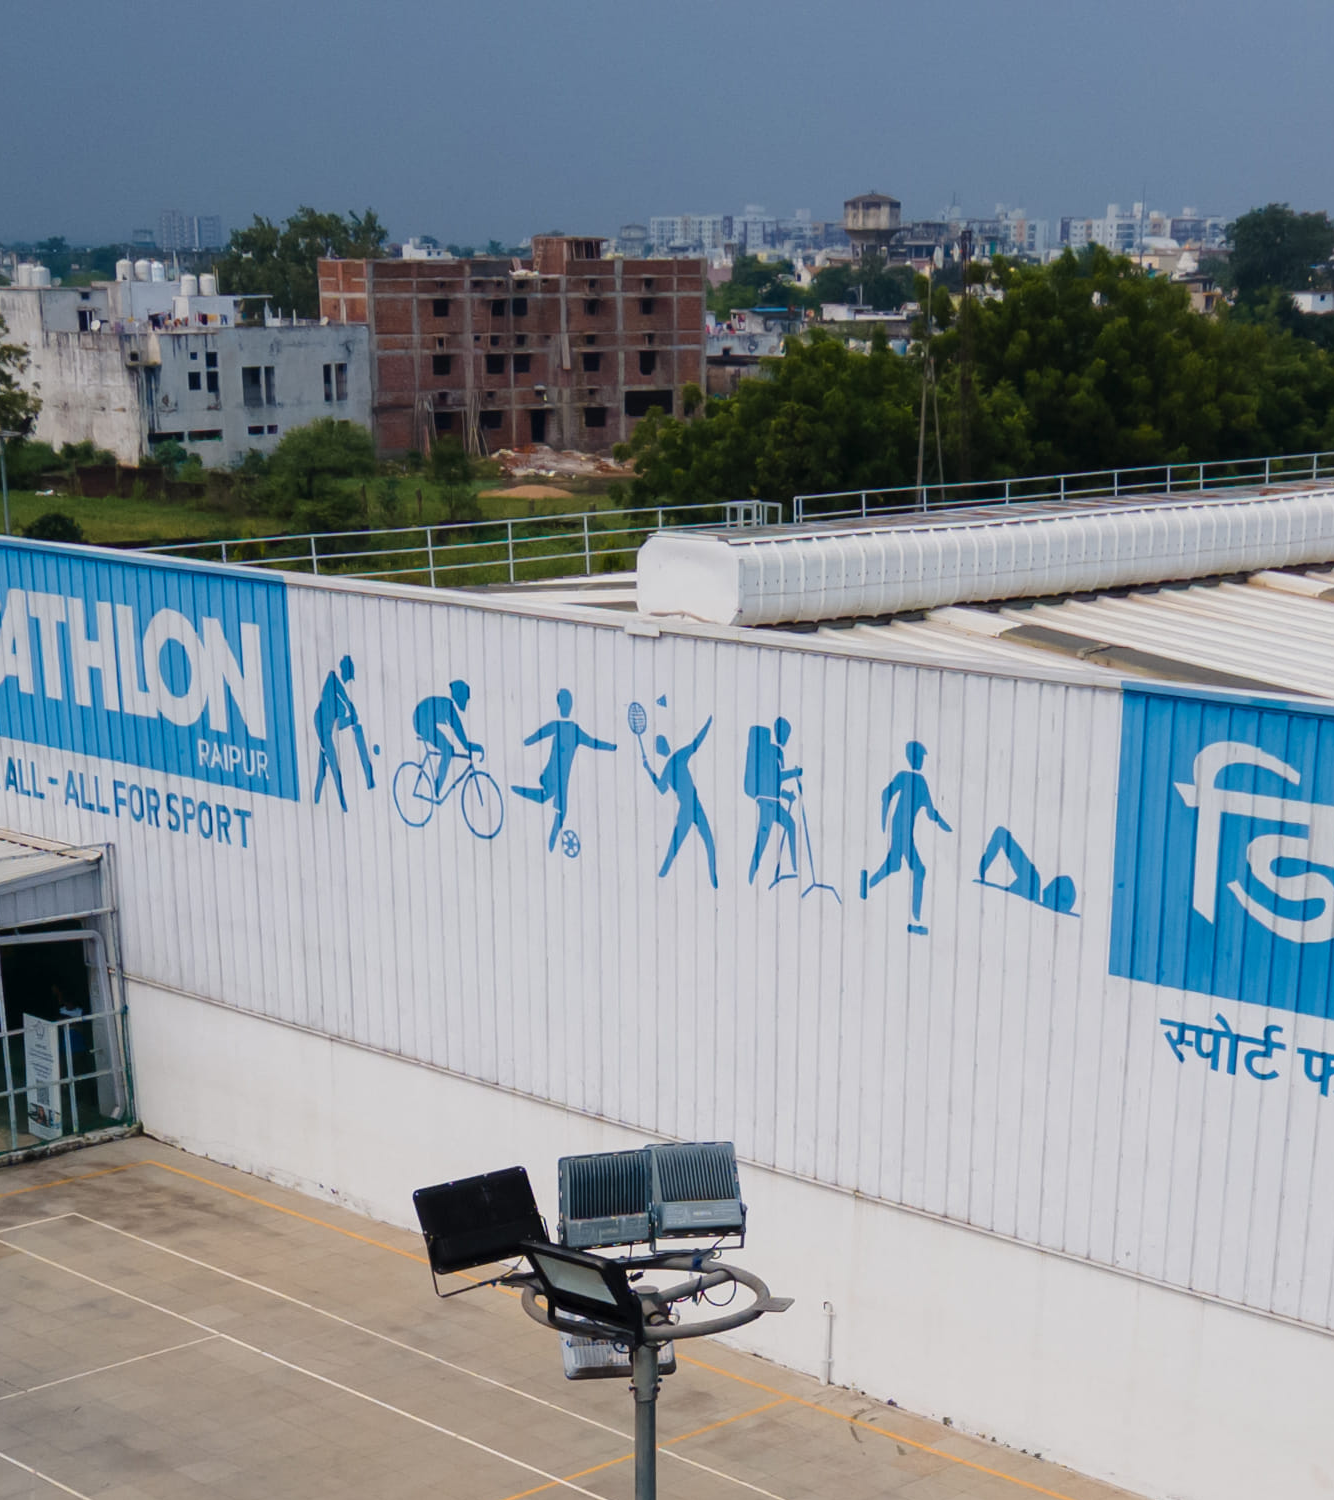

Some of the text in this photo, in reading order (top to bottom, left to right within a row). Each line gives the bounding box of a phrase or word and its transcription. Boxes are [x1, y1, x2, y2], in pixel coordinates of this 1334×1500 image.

[197, 738, 269, 780] RAIPUR
[4, 756, 46, 800] ALL
[47, 776, 59, 786] -
[64, 769, 110, 815] ALL
[112, 779, 161, 829] FOR
[166, 792, 252, 849] SPORT
[1160, 1013, 1286, 1081] स्पोर्ट
